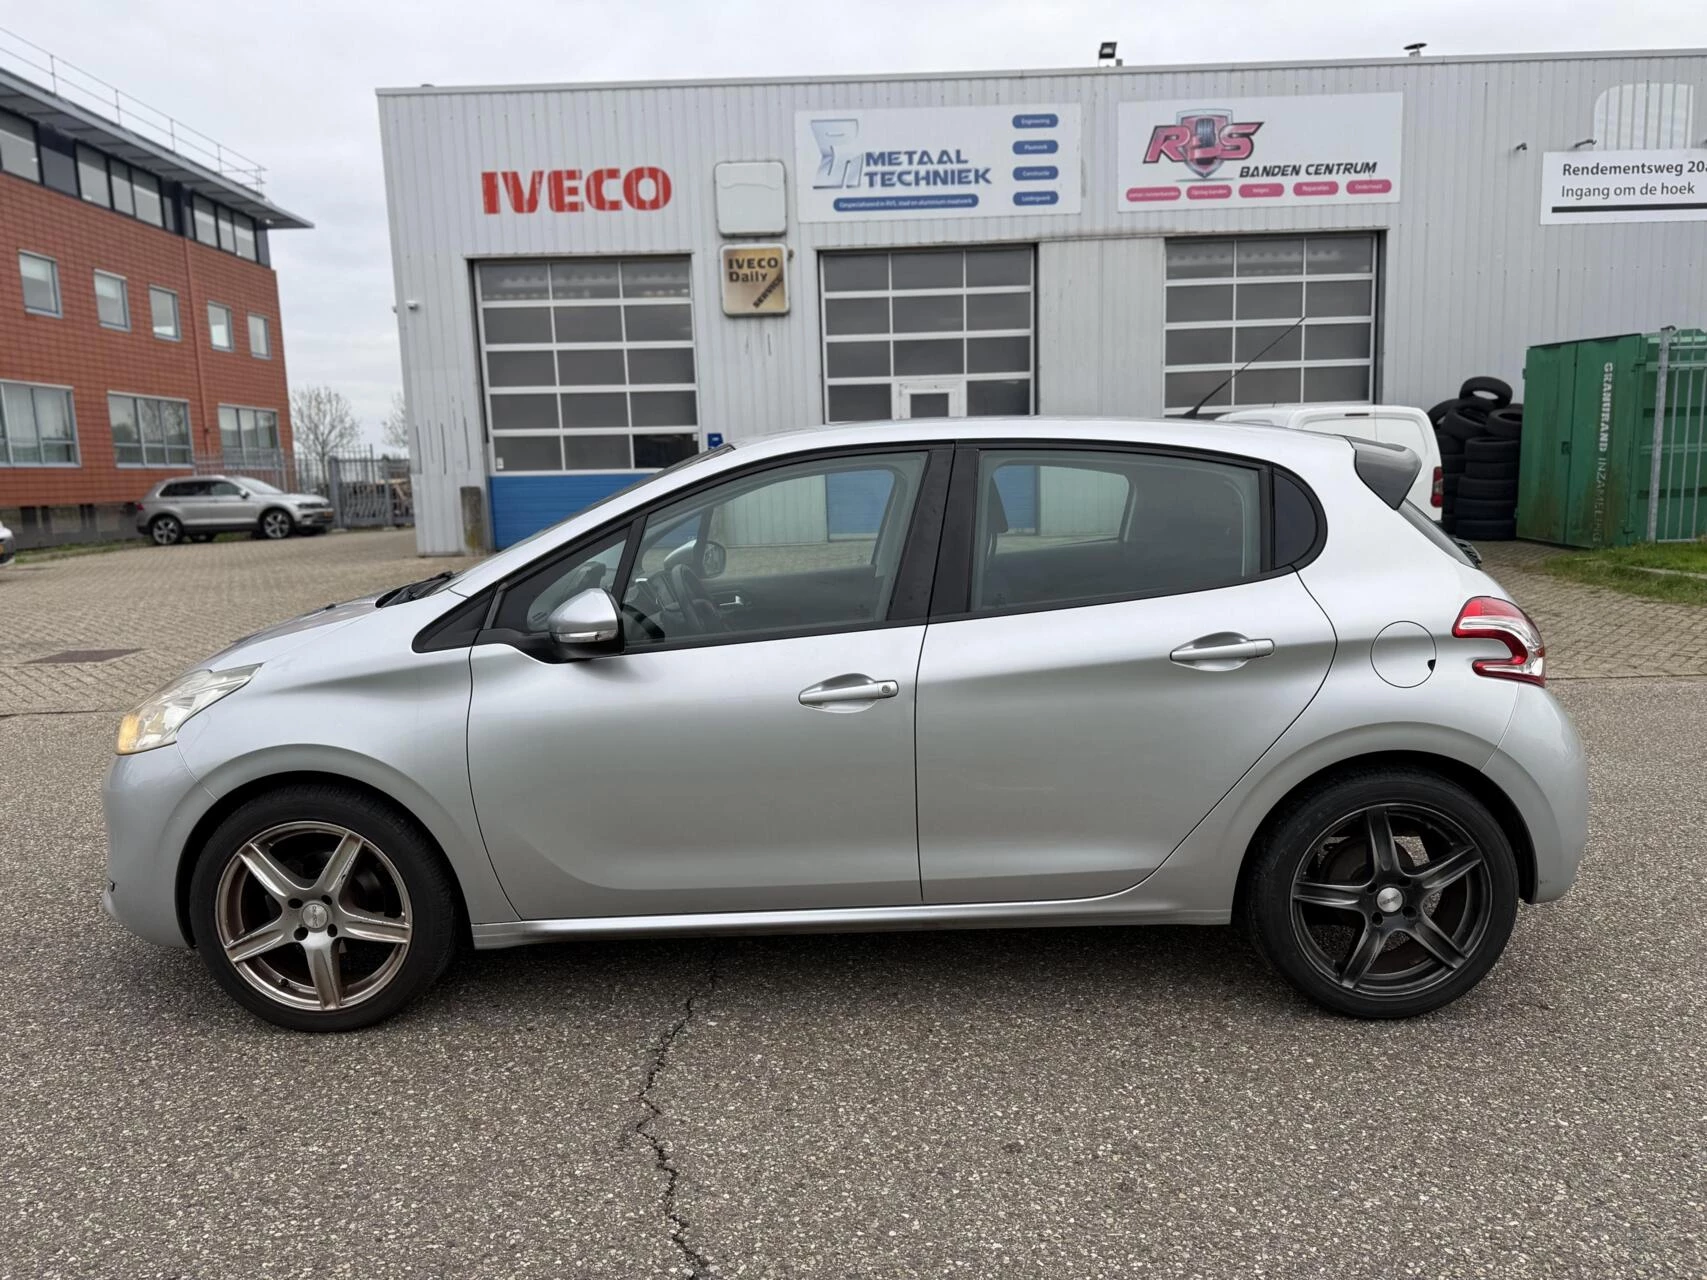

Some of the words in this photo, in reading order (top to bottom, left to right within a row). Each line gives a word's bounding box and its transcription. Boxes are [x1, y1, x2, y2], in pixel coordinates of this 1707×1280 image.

[865, 149, 969, 167] METAAL
[864, 167, 992, 188] TECHNIEK
[1239, 164, 1301, 179] BANDEN
[1304, 161, 1378, 176] CENTRUM
[1562, 162, 1684, 177] Rendementsweg
[1687, 160, 1707, 173] 20
[481, 166, 672, 215] IVECO
[1561, 184, 1610, 200] Ingang
[1613, 186, 1636, 196] om
[1639, 183, 1657, 195] de
[1660, 181, 1695, 195] hoek
[728, 257, 779, 269] IVECO
[728, 270, 768, 282] Daily
